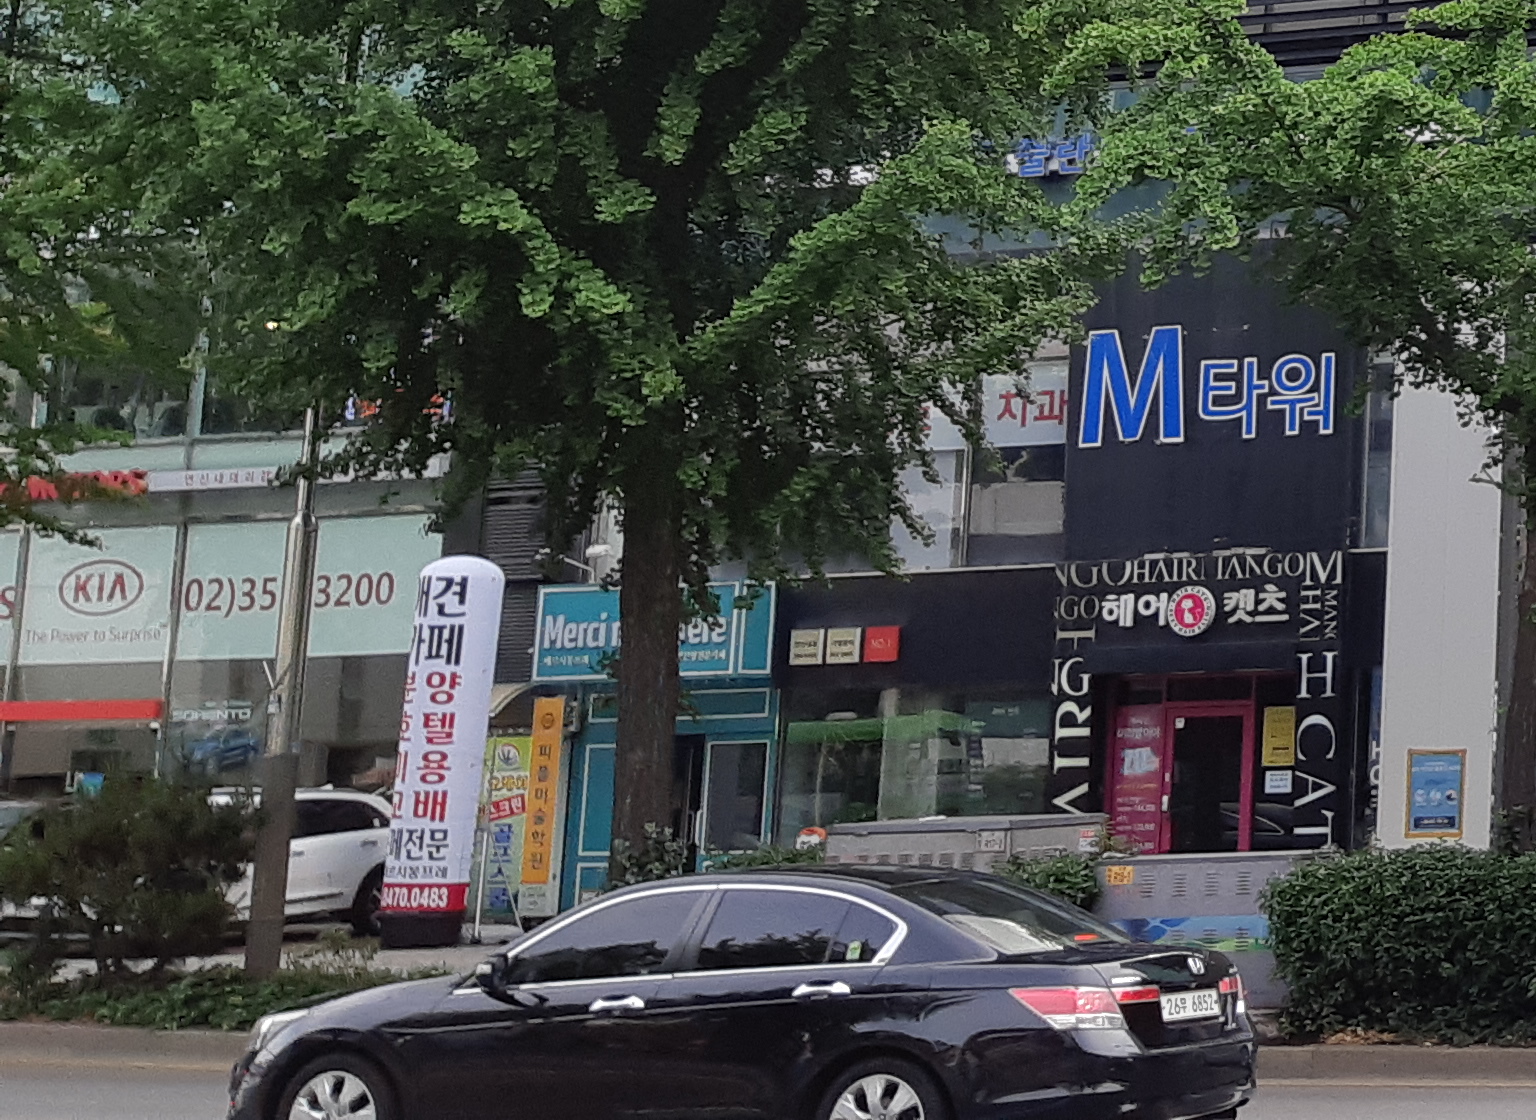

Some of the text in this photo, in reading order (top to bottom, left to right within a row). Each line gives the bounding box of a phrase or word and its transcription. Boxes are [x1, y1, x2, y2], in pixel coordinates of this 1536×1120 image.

[1078, 324, 1337, 449] M타워
[997, 389, 1068, 428] 치과
[72, 572, 128, 604] KIA
[1101, 583, 1291, 627] 헤어 캣츠
[25, 628, 48, 643] The
[542, 611, 608, 650] Merci
[1191, 993, 1215, 1013] 6852
